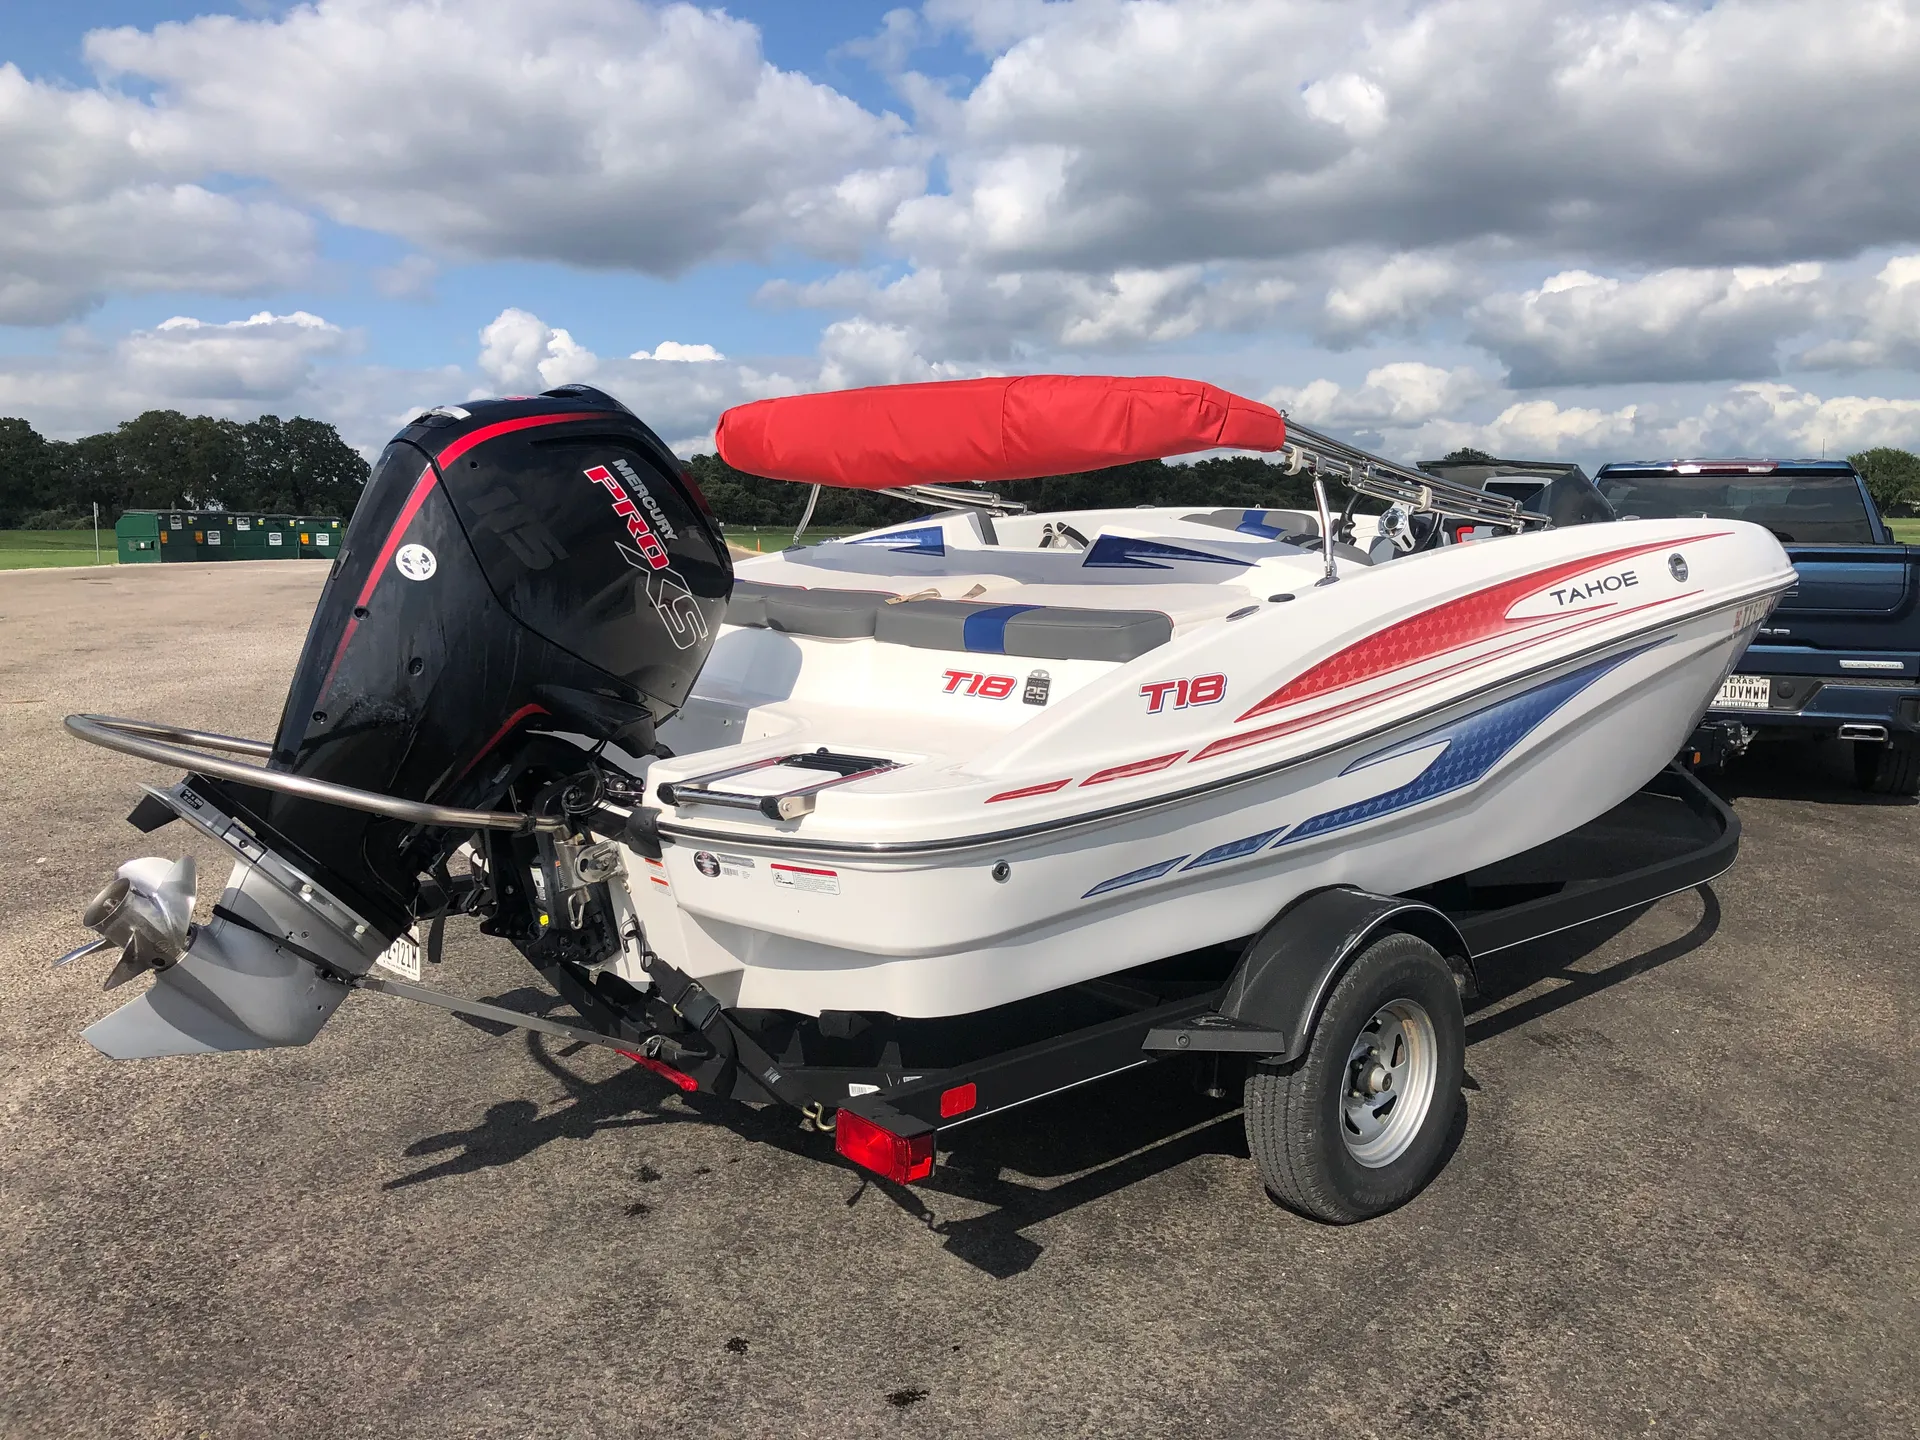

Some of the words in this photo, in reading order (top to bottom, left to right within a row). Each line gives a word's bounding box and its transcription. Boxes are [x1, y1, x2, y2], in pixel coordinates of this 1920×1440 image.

[584, 465, 669, 570] PRO
[612, 458, 678, 541] MERCURY
[1549, 570, 1639, 606] TAHOE
[942, 668, 1017, 701] T18
[1025, 685, 1048, 701] 25
[1139, 671, 1228, 715] T18
